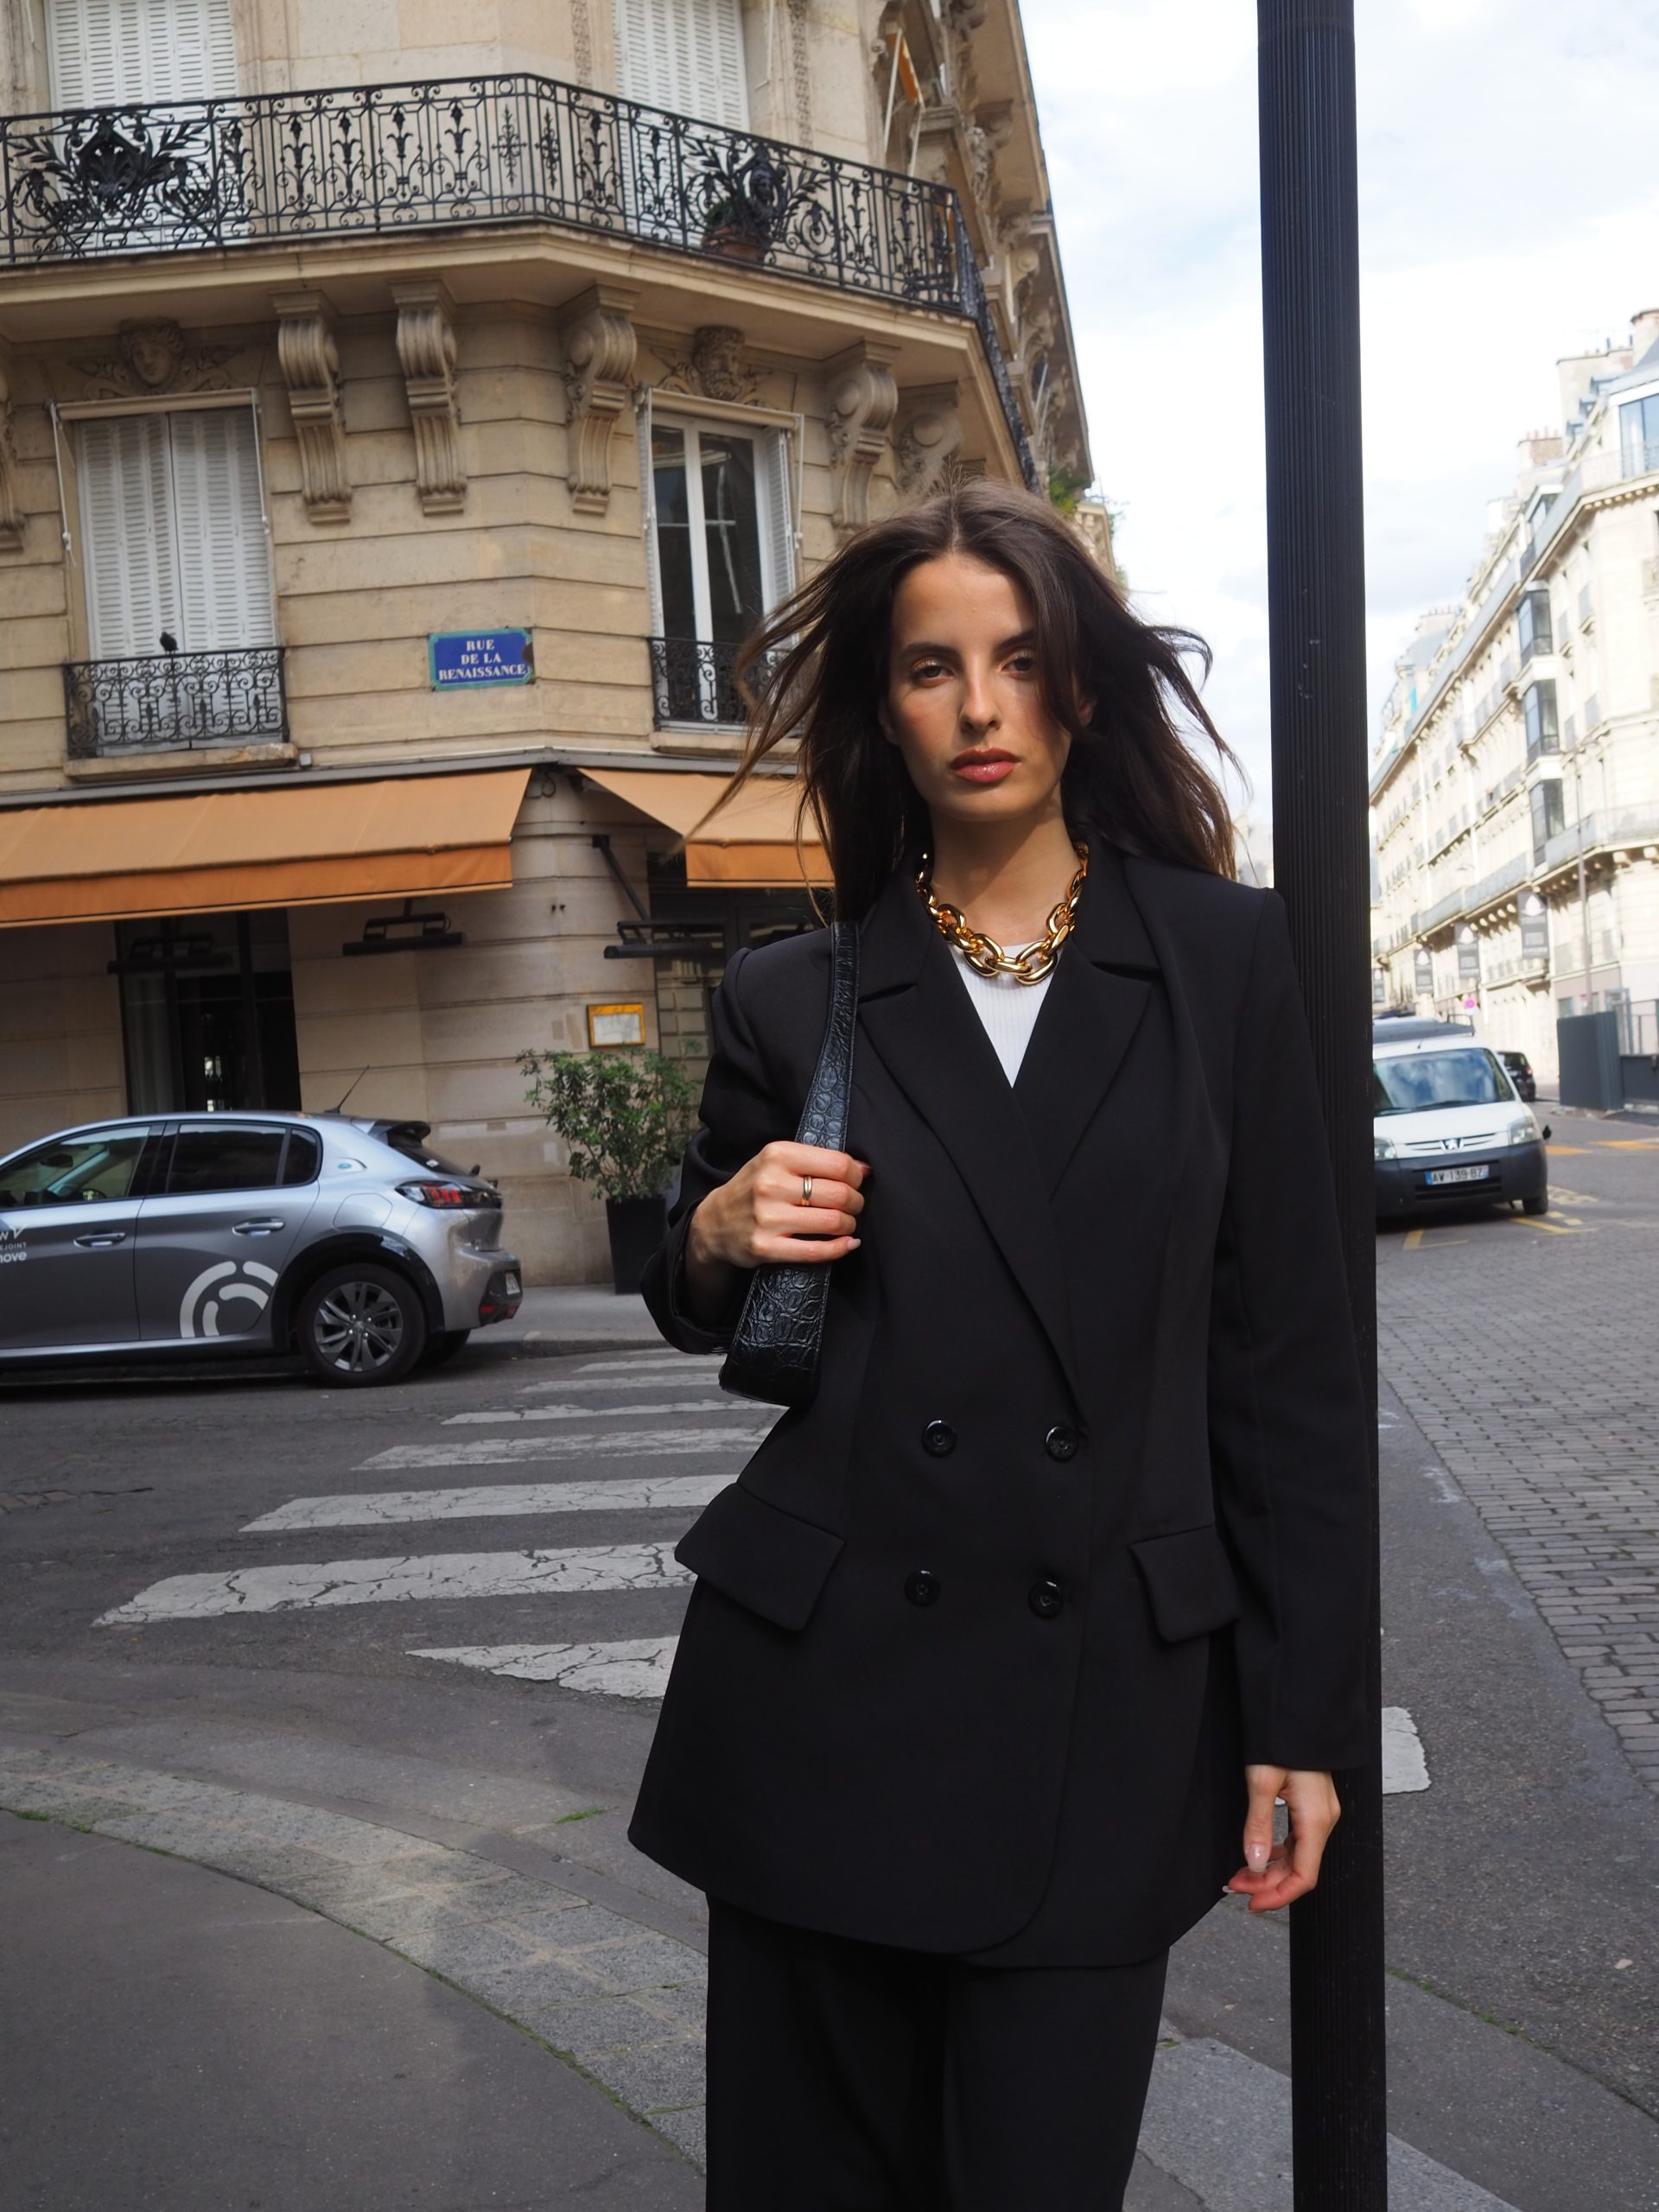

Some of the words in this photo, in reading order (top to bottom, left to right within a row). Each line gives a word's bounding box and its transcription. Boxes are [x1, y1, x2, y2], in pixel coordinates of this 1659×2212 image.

[467, 639, 495, 652] RUE
[461, 653, 479, 665] DE
[484, 652, 502, 664] LA
[438, 664, 526, 681] RENAISSANCE
